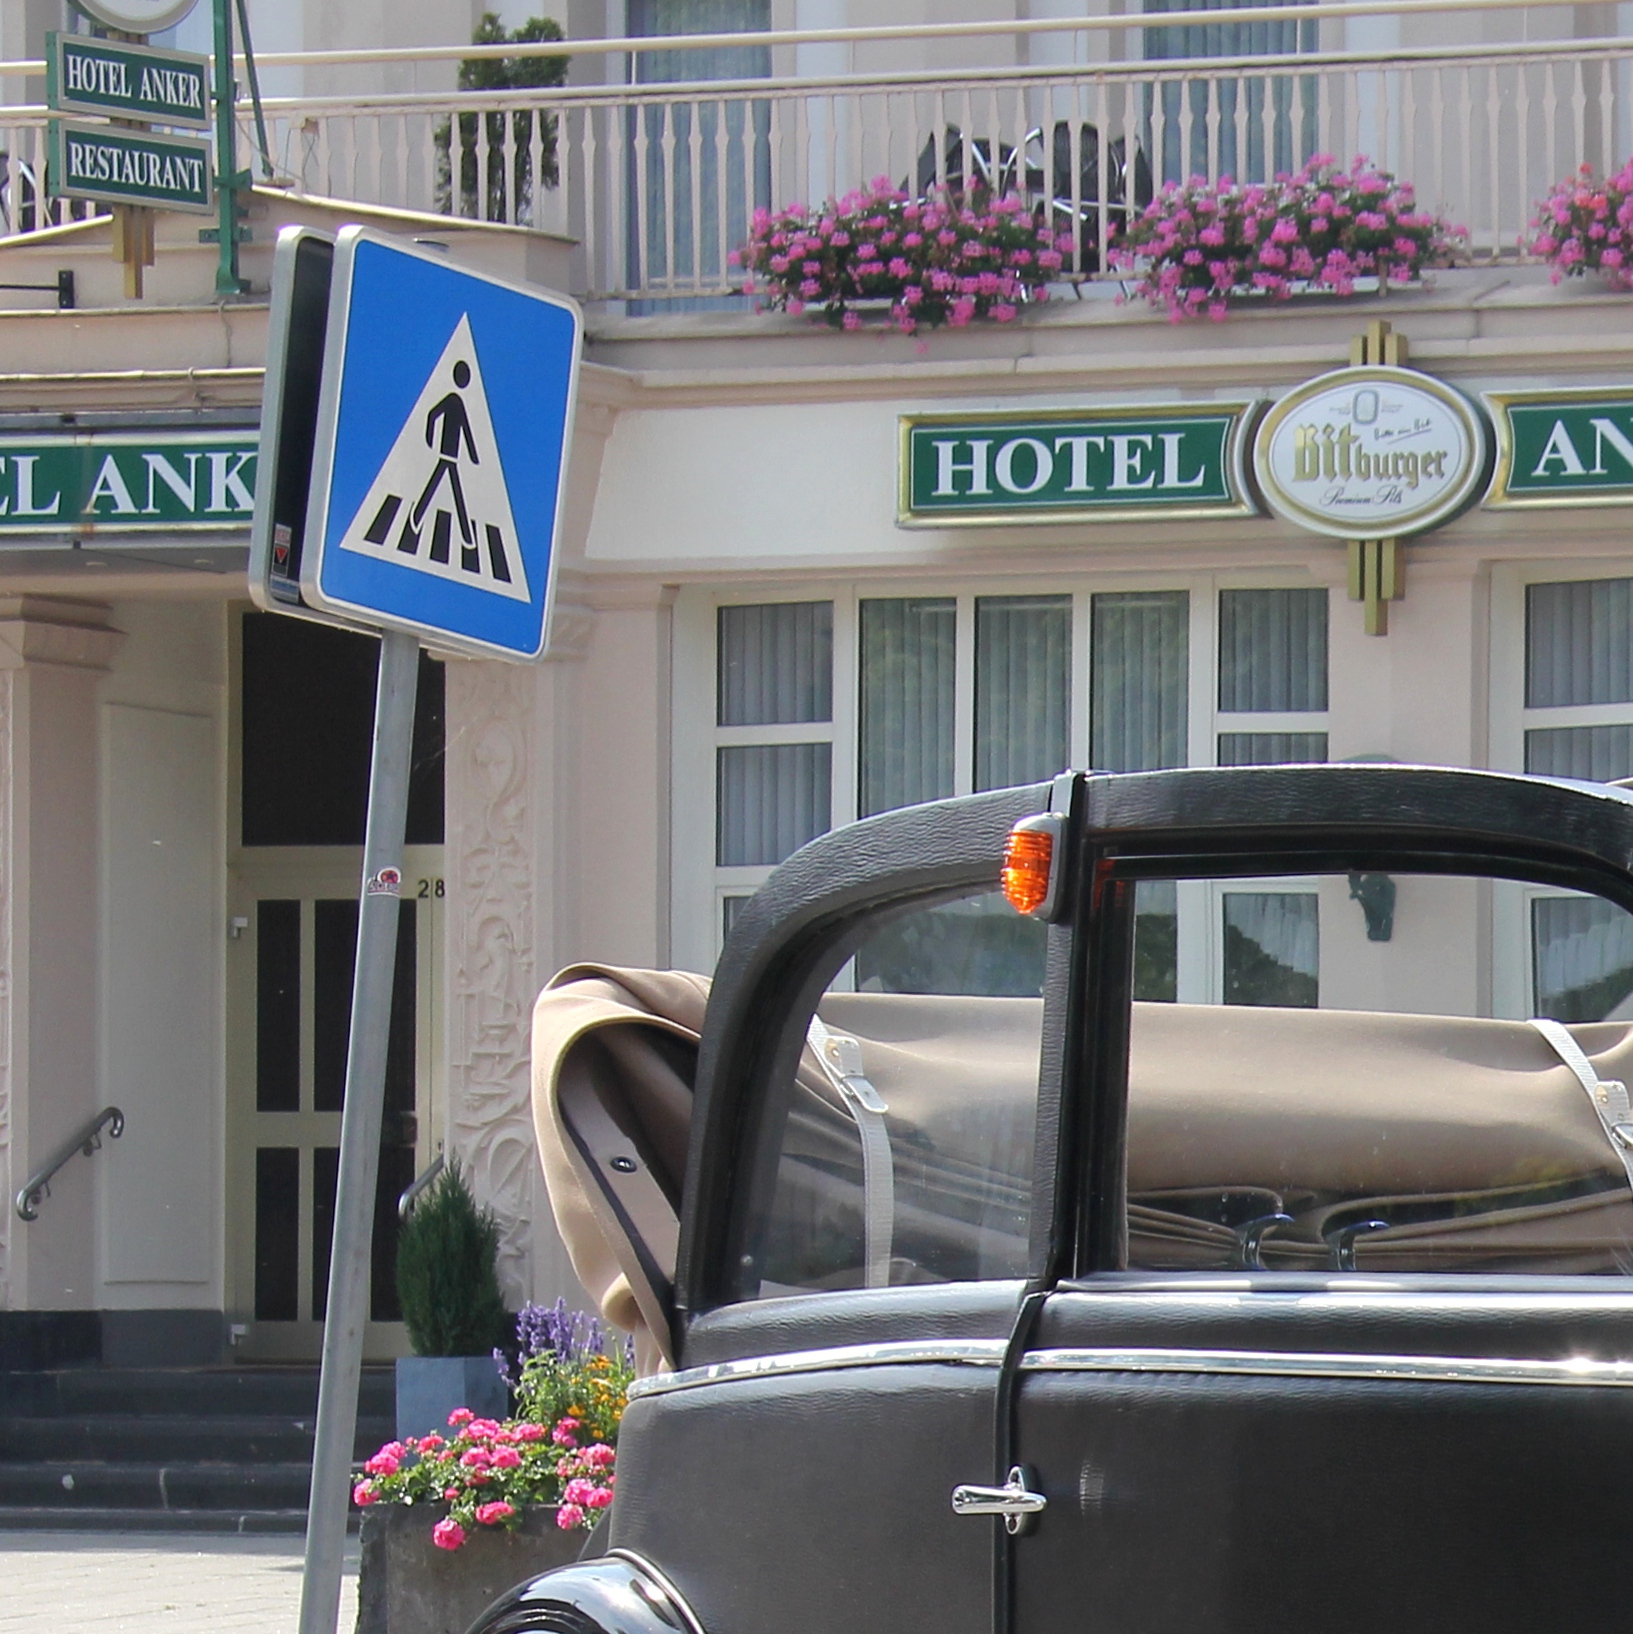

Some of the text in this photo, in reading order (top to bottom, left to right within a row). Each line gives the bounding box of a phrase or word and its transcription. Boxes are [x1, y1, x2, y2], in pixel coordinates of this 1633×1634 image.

[67, 53, 201, 109] HOTEL ANKER
[69, 141, 204, 194] RESTAURANT
[931, 433, 1206, 498] HOTEL
[1292, 422, 1448, 489] Bitburger
[1320, 486, 1372, 506] Premium
[418, 879, 445, 899] 28
